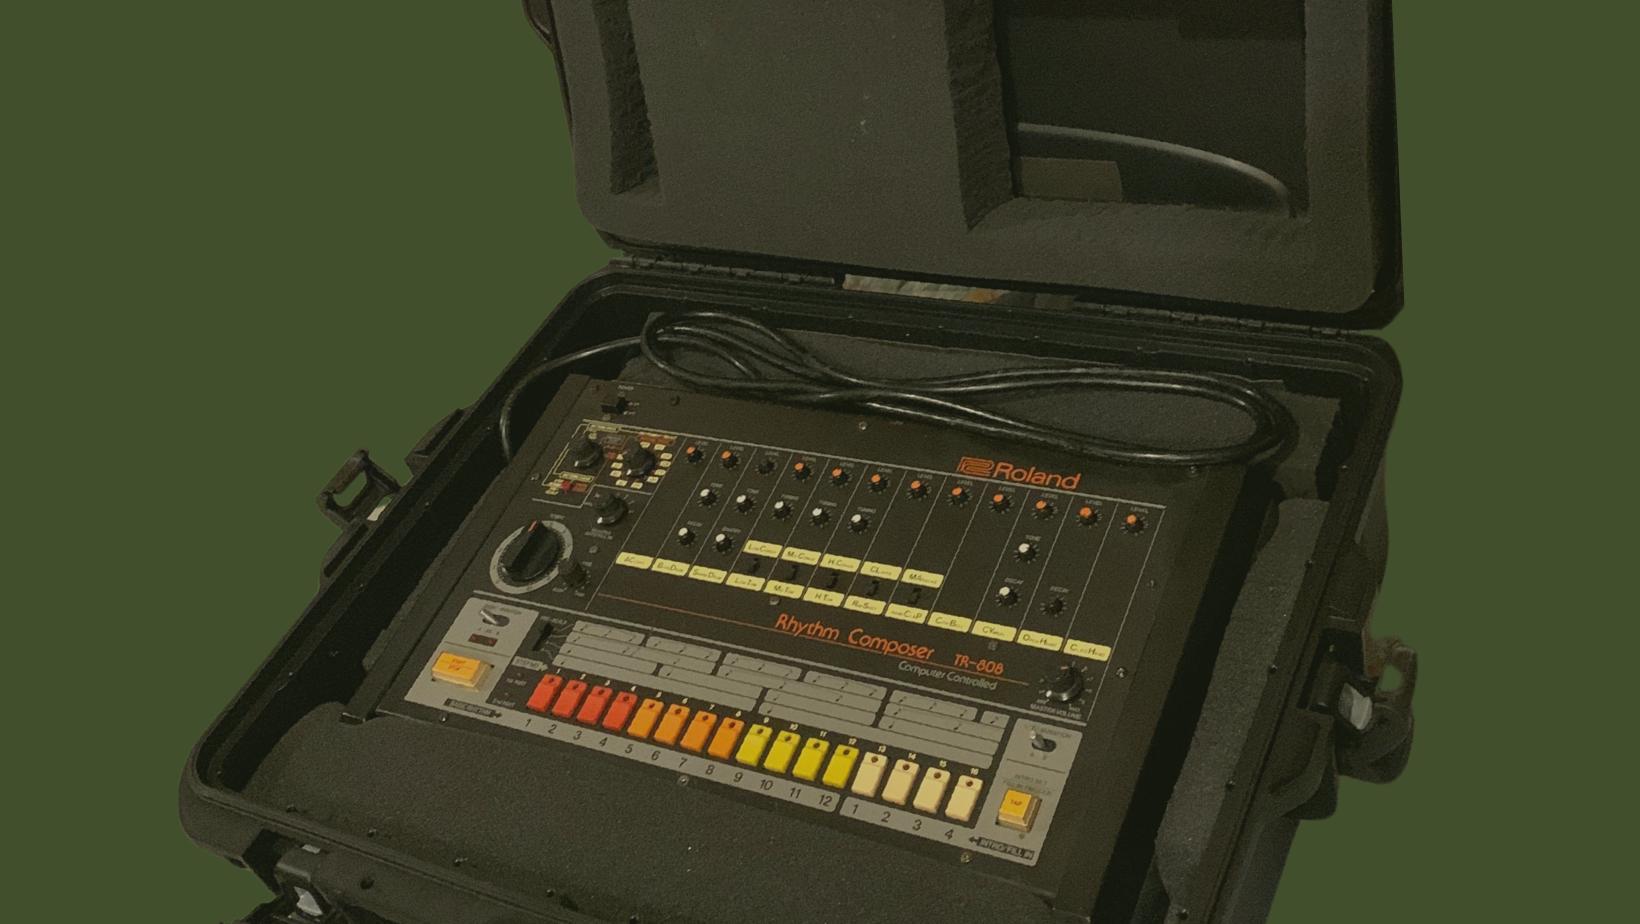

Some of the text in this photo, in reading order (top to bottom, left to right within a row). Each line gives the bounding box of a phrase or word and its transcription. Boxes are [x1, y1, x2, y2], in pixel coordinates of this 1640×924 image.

[992, 462, 1082, 490] Roland
[775, 613, 935, 660] Rhythm Composer
[898, 660, 998, 690] Computer Controlled
[954, 654, 1004, 675] TR-808
[525, 718, 833, 807] 1 2 3 4 5 6 7 8 9 10 11 12
[848, 738, 857, 746] 12
[878, 745, 887, 753] 13
[970, 768, 979, 776] 16
[1010, 798, 1022, 806] TAP
[852, 804, 954, 840] 1 2 3 4
